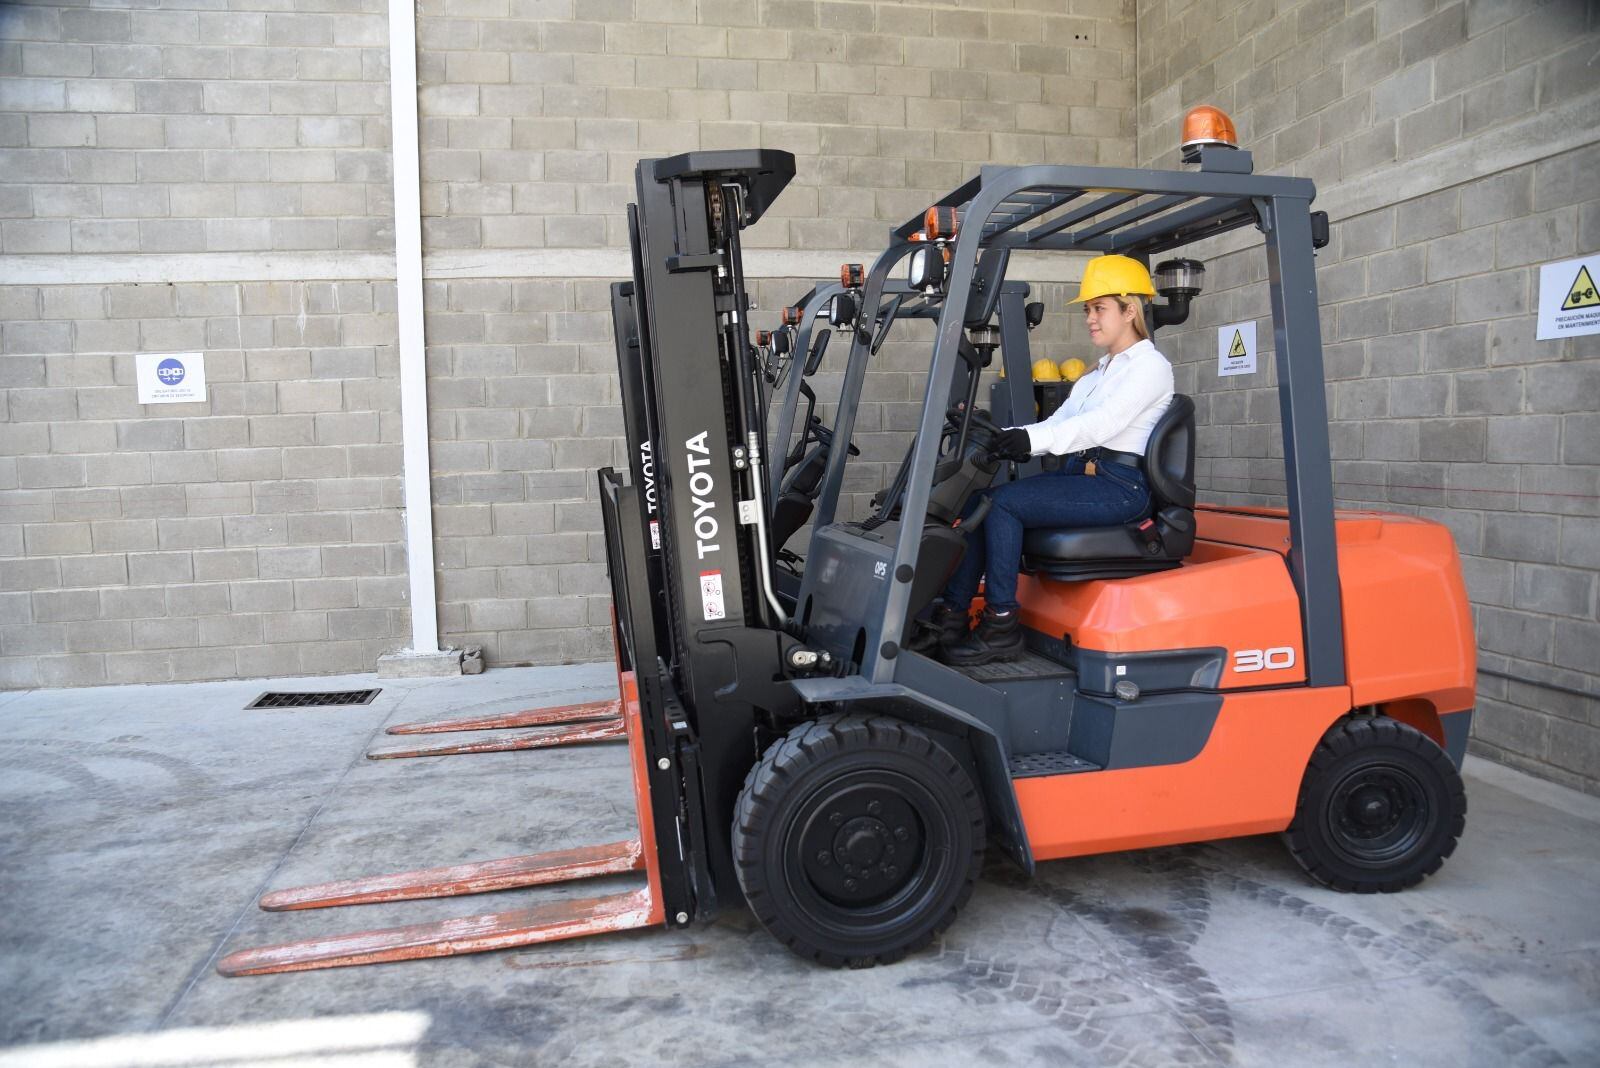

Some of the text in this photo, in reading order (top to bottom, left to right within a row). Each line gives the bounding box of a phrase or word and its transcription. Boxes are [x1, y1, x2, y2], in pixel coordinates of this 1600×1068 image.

[640, 440, 657, 514] TOYOTA
[686, 431, 720, 559] TOYOTA
[875, 561, 888, 576] OPS
[1233, 646, 1295, 673] 30
